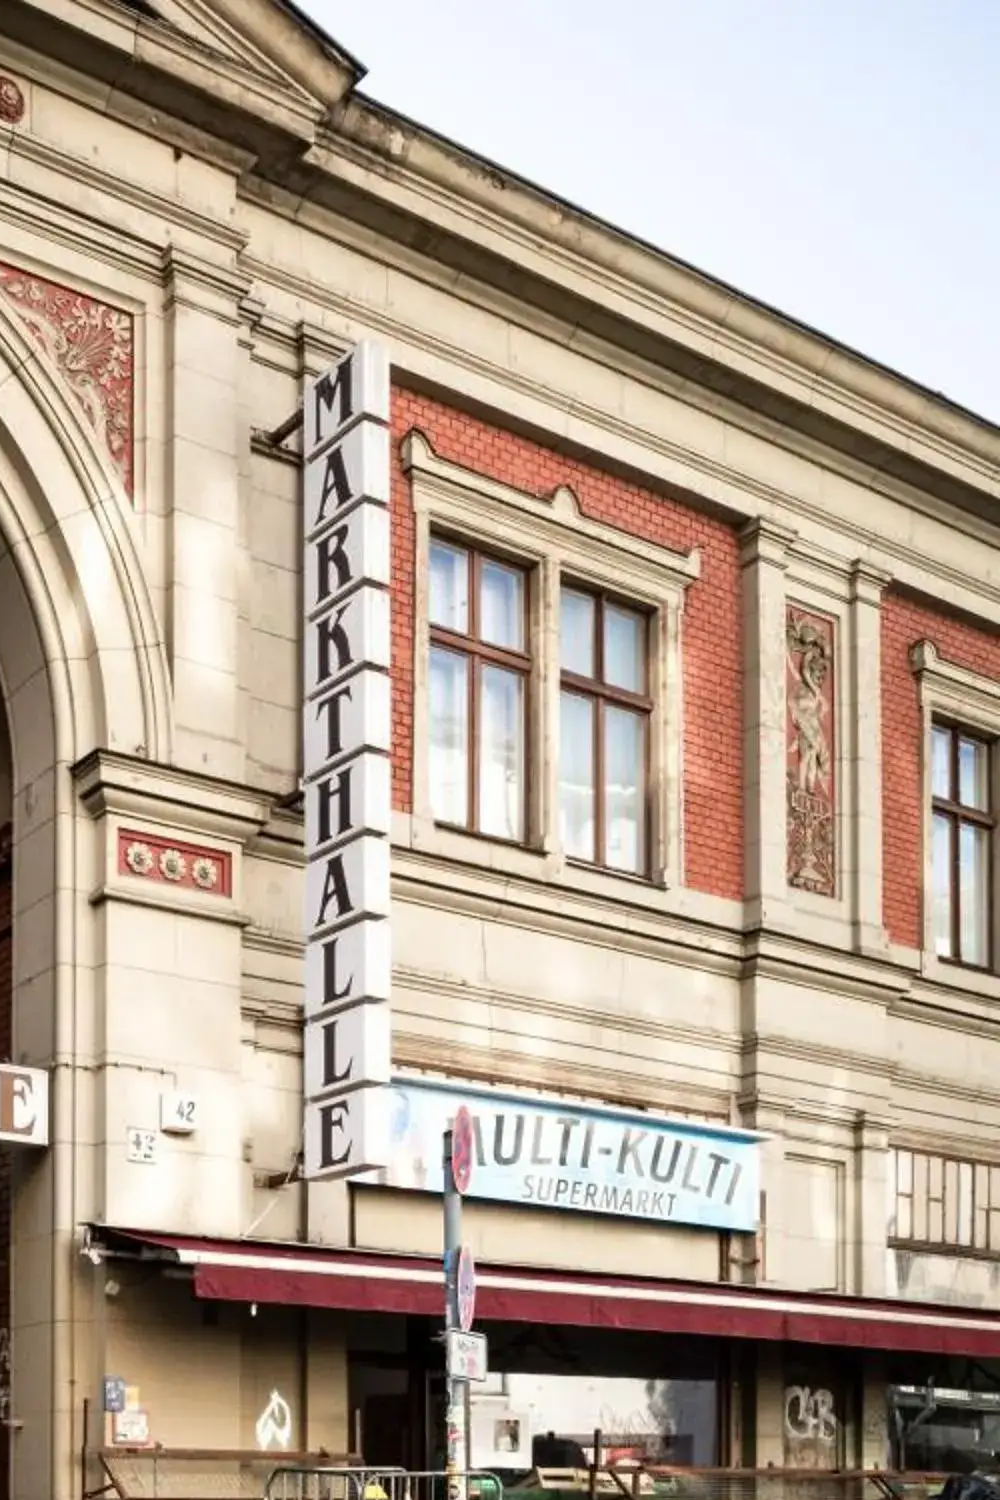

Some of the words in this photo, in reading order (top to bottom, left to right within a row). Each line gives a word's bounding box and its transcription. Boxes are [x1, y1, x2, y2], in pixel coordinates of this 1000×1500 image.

[314, 352, 355, 1168] MARKTHALLE
[176, 1100, 196, 1123] 42
[521, 1174, 678, 1217] SUPERMARKT
